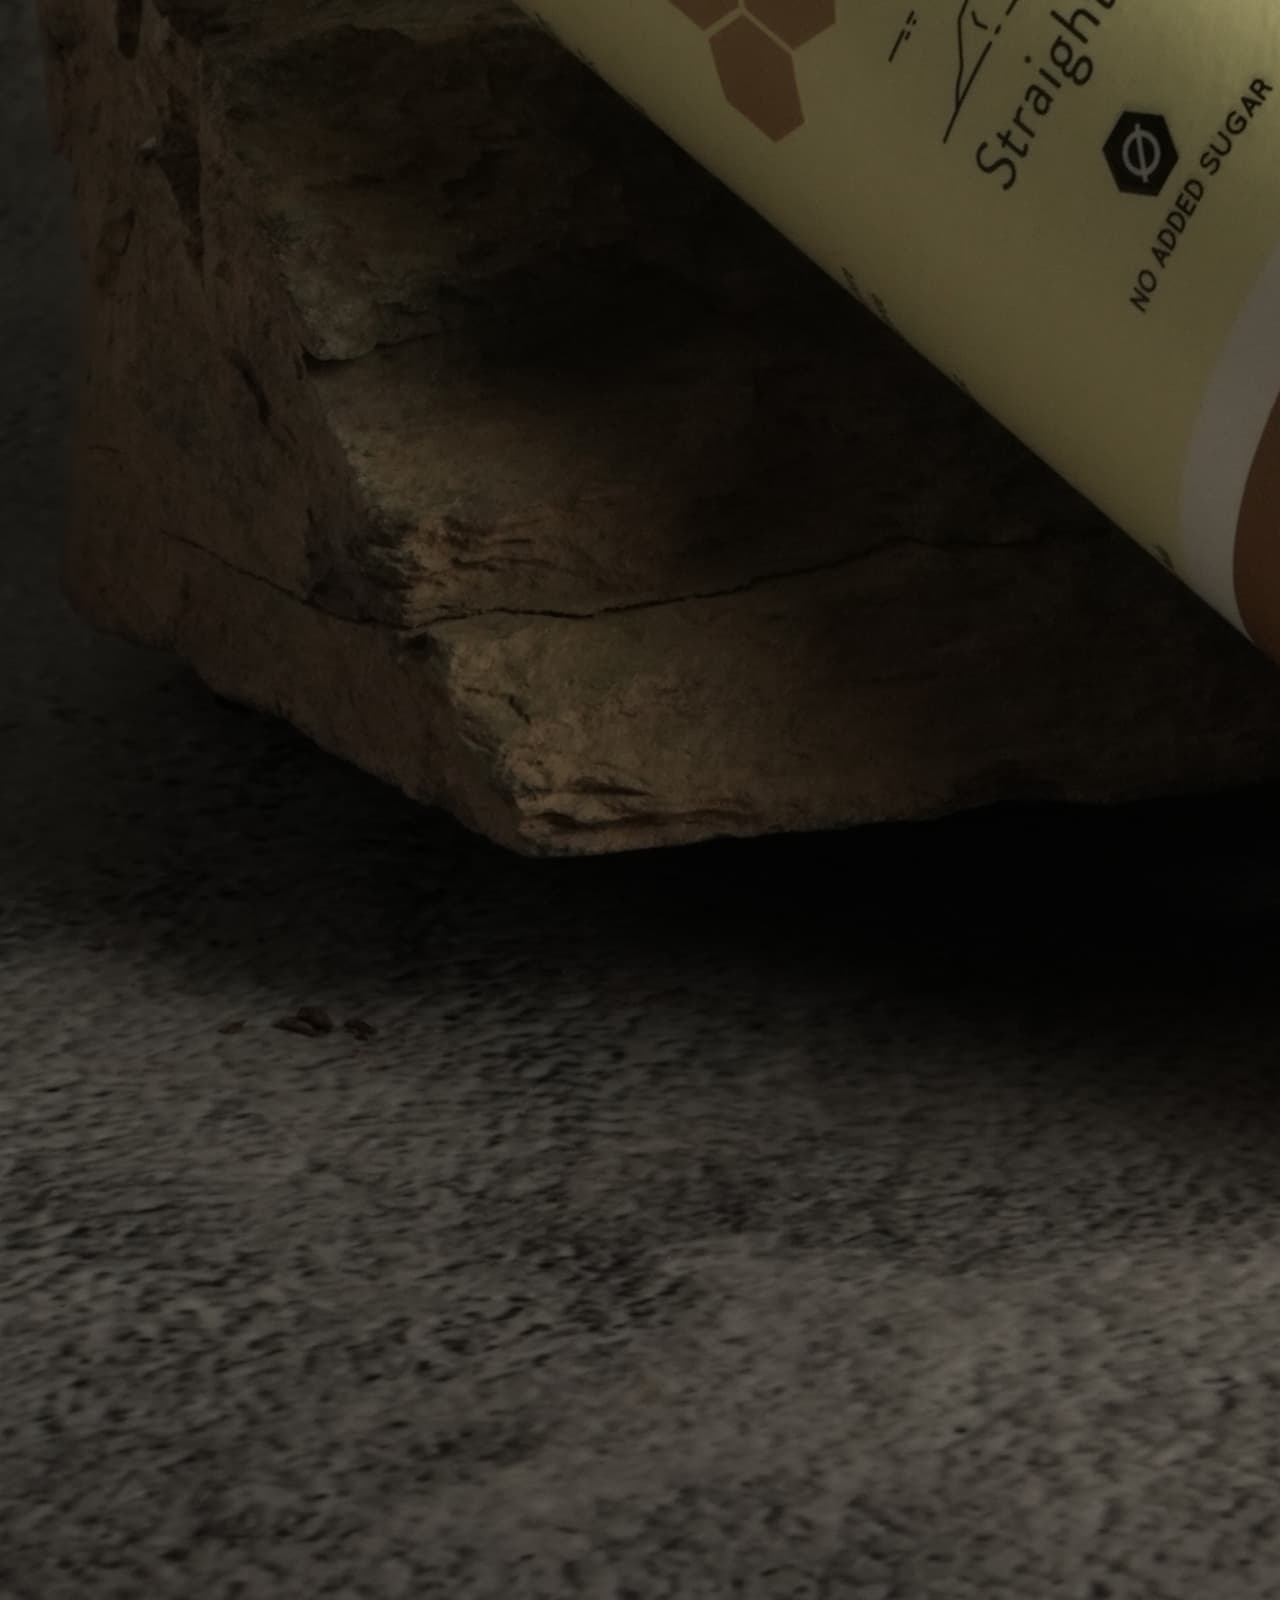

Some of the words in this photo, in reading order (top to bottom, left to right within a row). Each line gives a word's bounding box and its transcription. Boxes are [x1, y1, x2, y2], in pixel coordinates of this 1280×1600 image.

[1130, 267, 1159, 314] NO
[1155, 177, 1205, 270] ADDED
[1200, 77, 1274, 177] SUGAR
